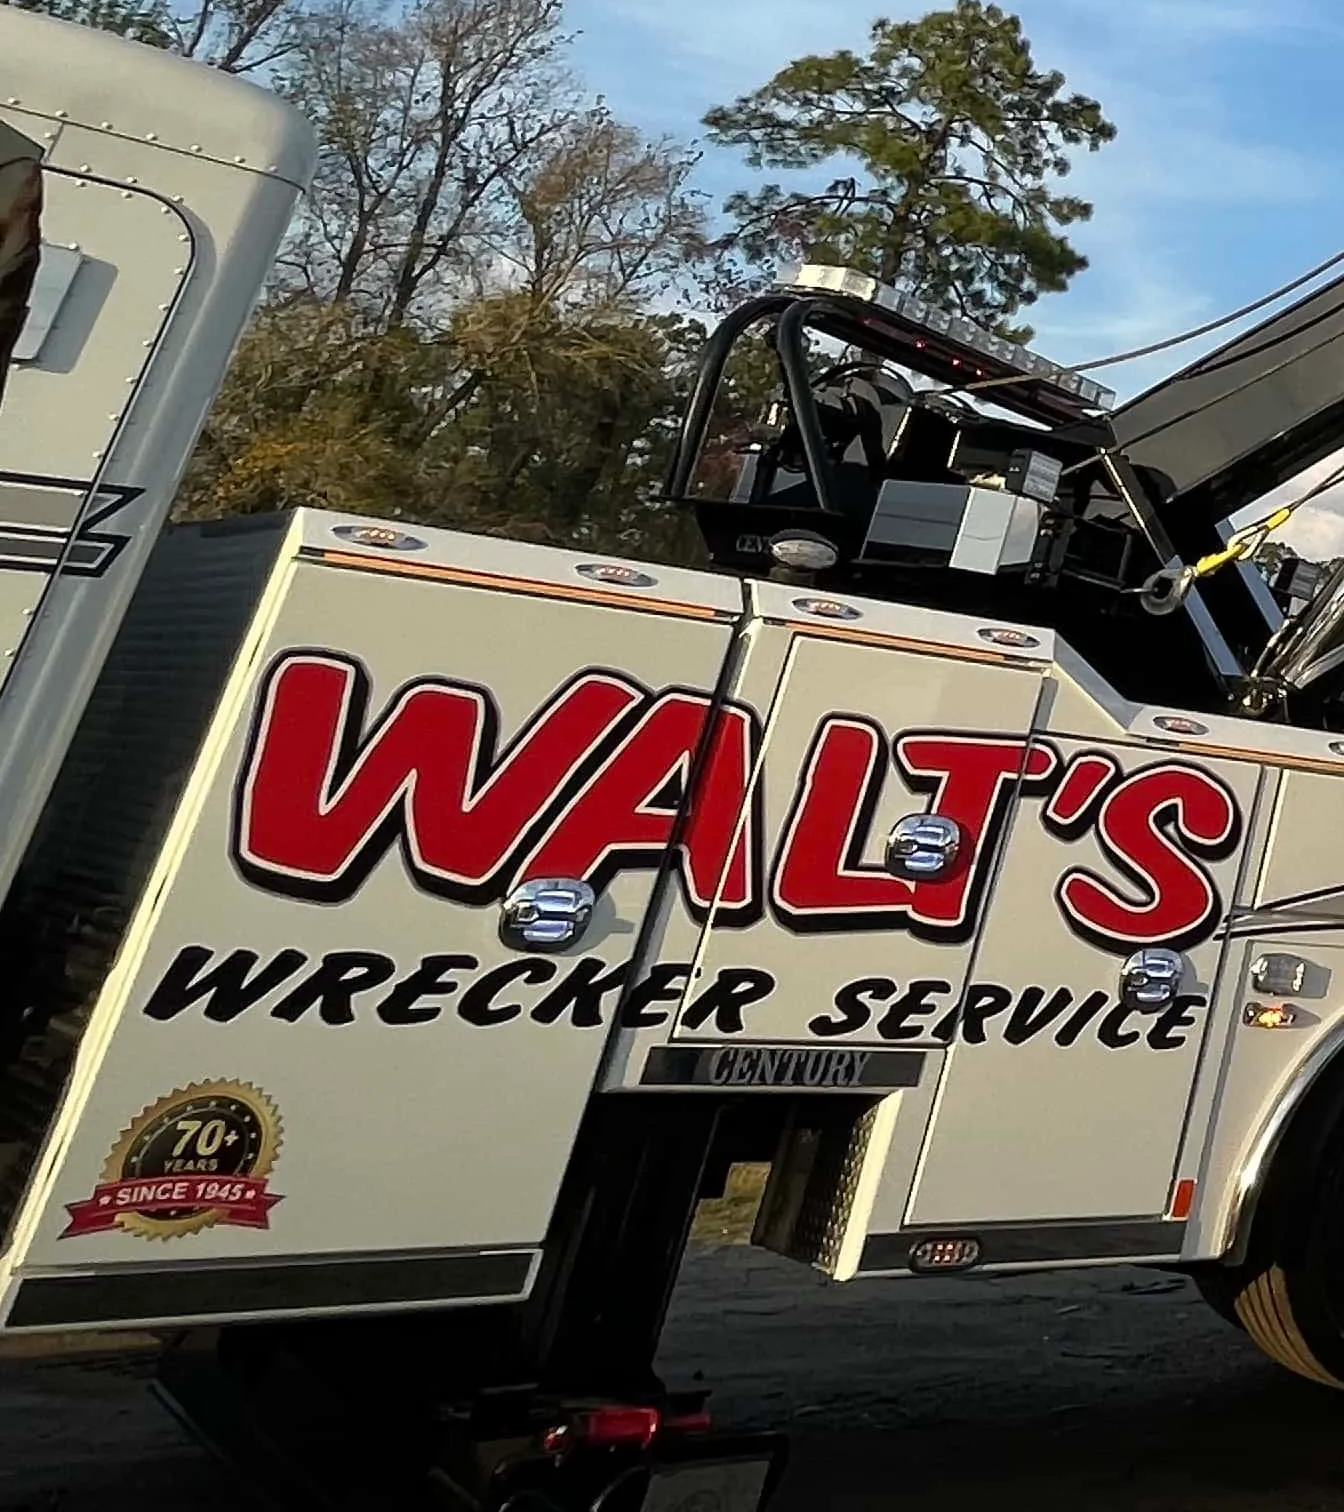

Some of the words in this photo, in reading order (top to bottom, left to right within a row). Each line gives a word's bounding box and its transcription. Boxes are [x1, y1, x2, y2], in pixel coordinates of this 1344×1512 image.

[231, 647, 1241, 951] WALT'S
[144, 945, 777, 1036] WRECKER
[807, 975, 1208, 1050] SERVICE
[709, 1046, 873, 1087] CENTURY
[163, 1158, 219, 1173] YEARS
[115, 1182, 187, 1206] SINCE
[197, 1181, 243, 1202] 1945
